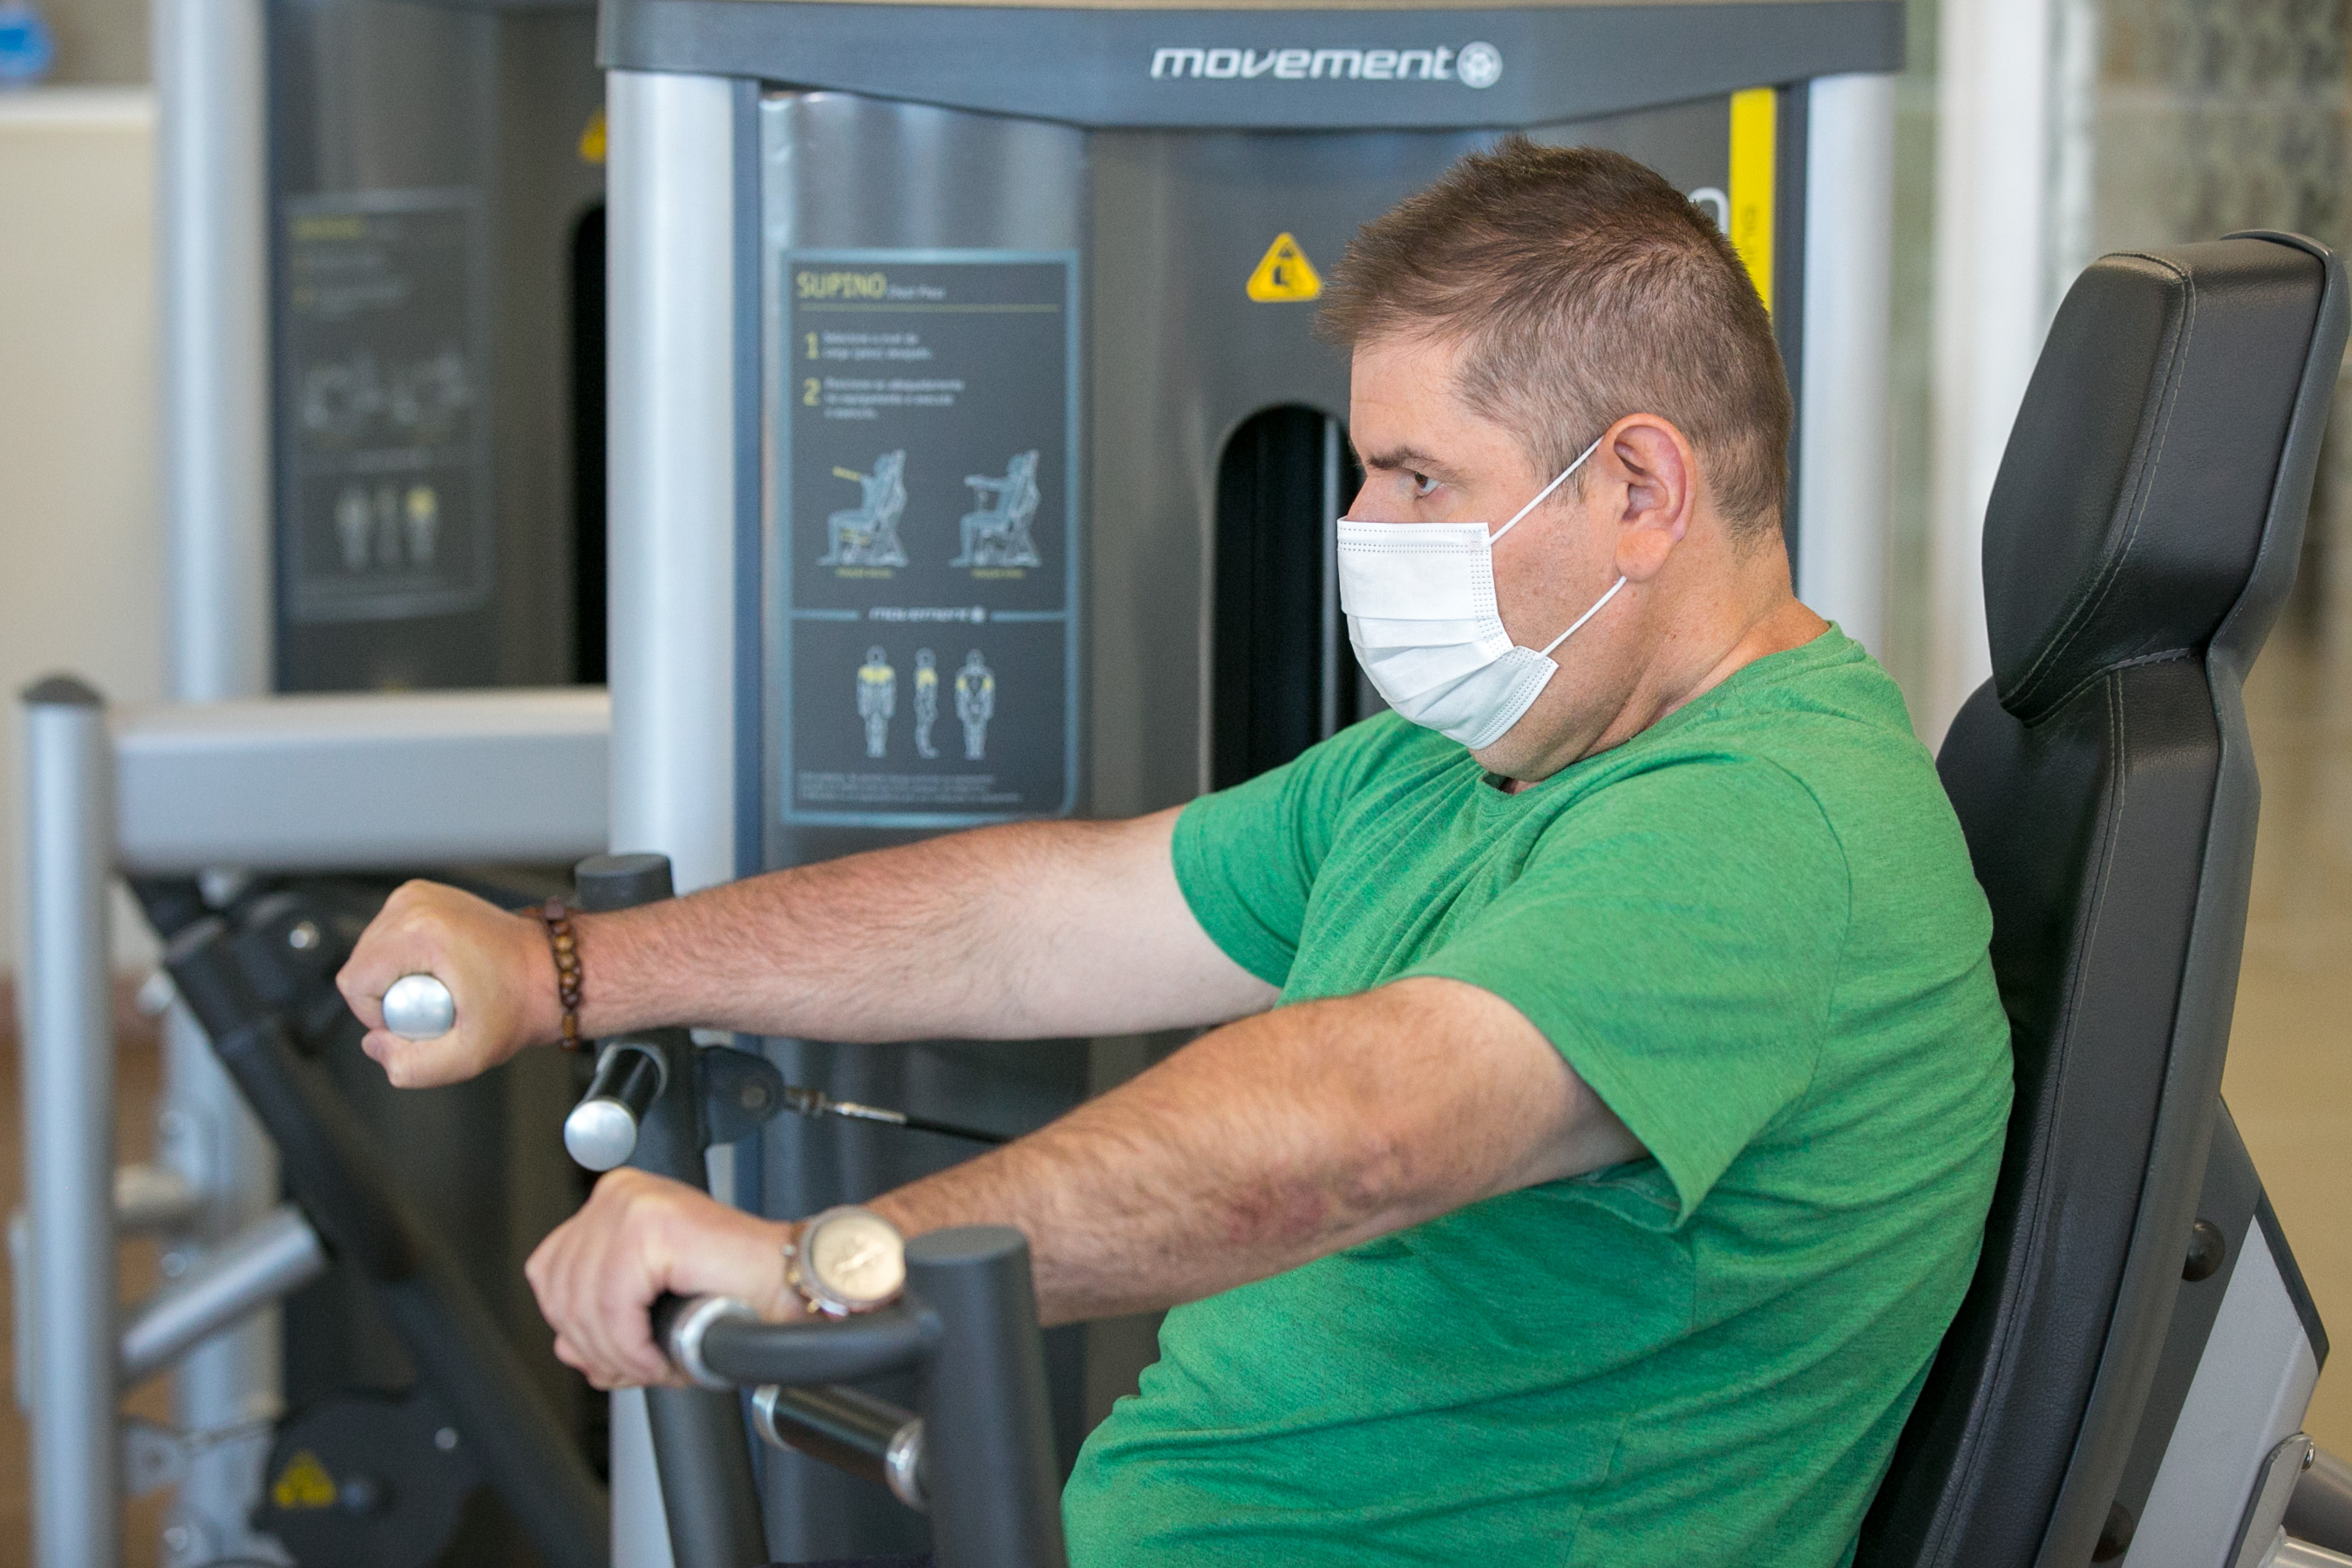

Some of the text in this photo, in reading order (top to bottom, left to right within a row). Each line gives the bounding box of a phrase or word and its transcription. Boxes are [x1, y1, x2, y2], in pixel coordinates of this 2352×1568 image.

[1150, 45, 1454, 80] movement
[797, 271, 887, 298] SUPINO
[805, 331, 819, 359] 1
[803, 377, 821, 406] 2
